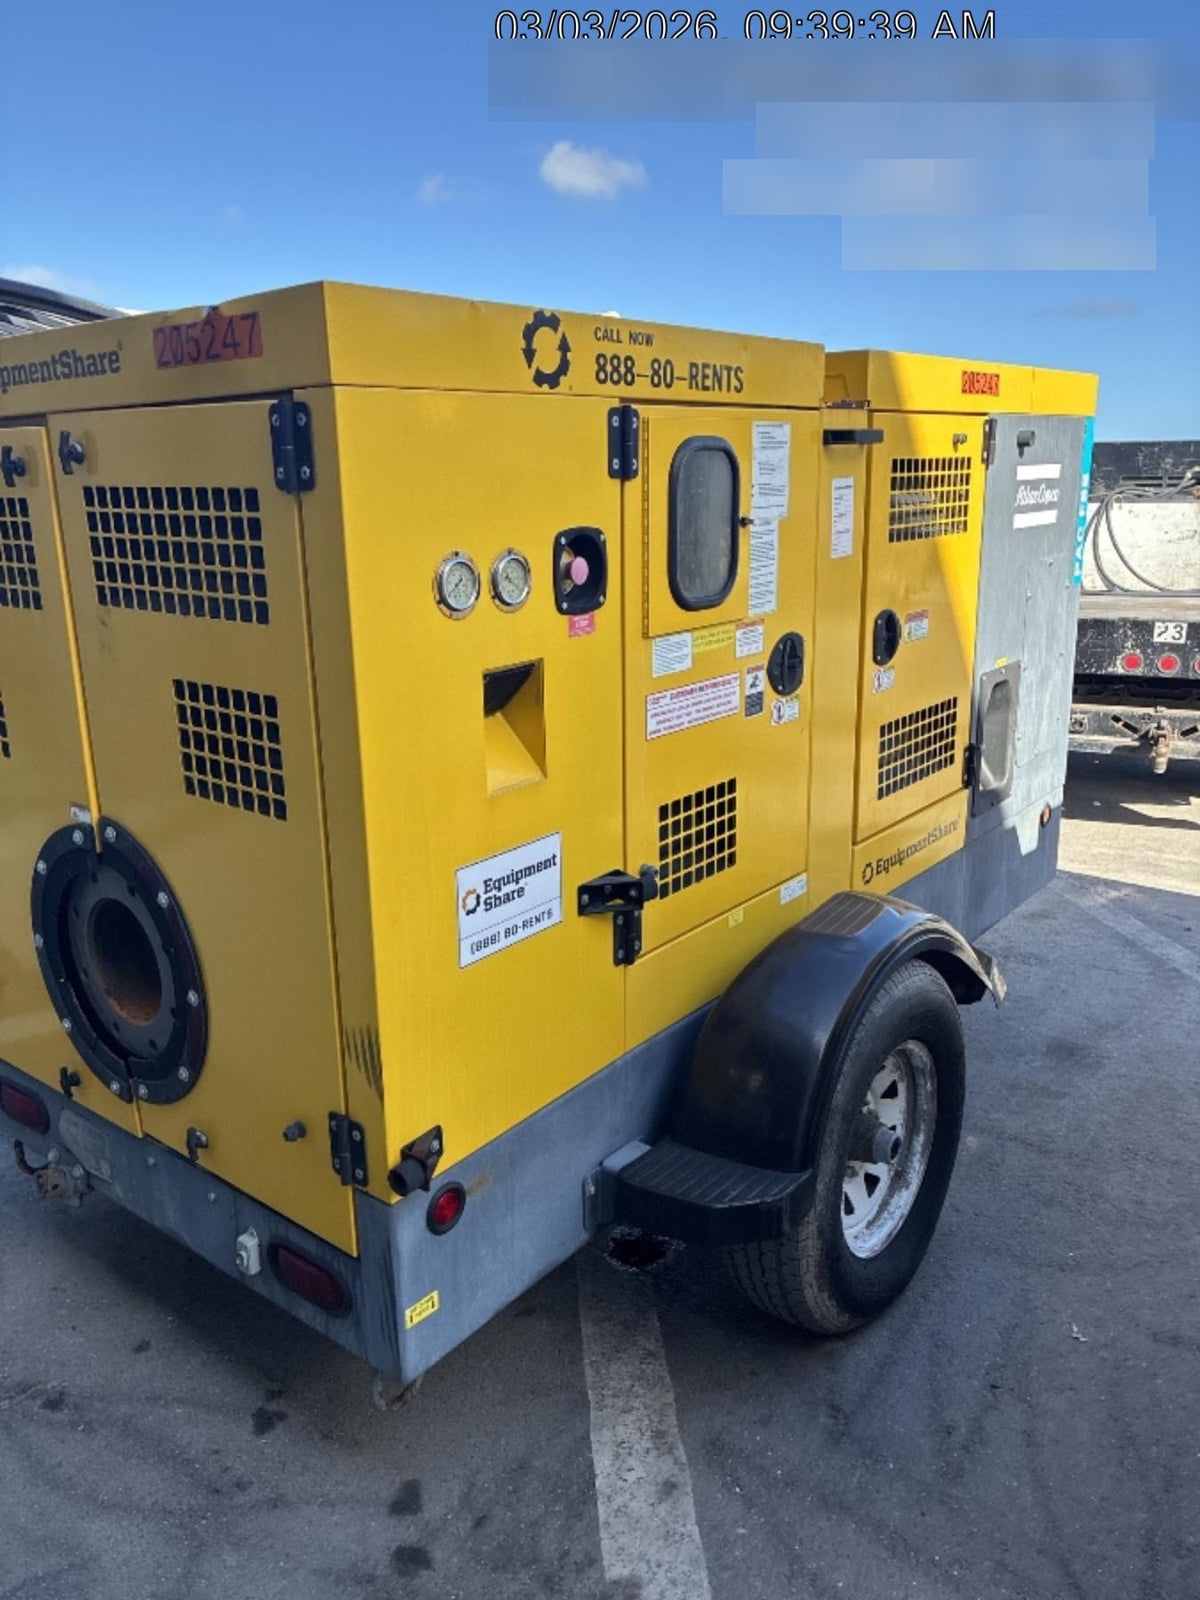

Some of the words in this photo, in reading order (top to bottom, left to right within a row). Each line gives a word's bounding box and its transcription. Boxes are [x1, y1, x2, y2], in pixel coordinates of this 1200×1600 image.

[155, 312, 258, 367] 205247
[594, 326, 622, 344] CALL
[629, 331, 655, 347] NOW
[595, 353, 744, 394] 888-80-RENTS
[1157, 623, 1184, 641] 23
[483, 853, 557, 894] Equipment
[484, 886, 525, 912] Share
